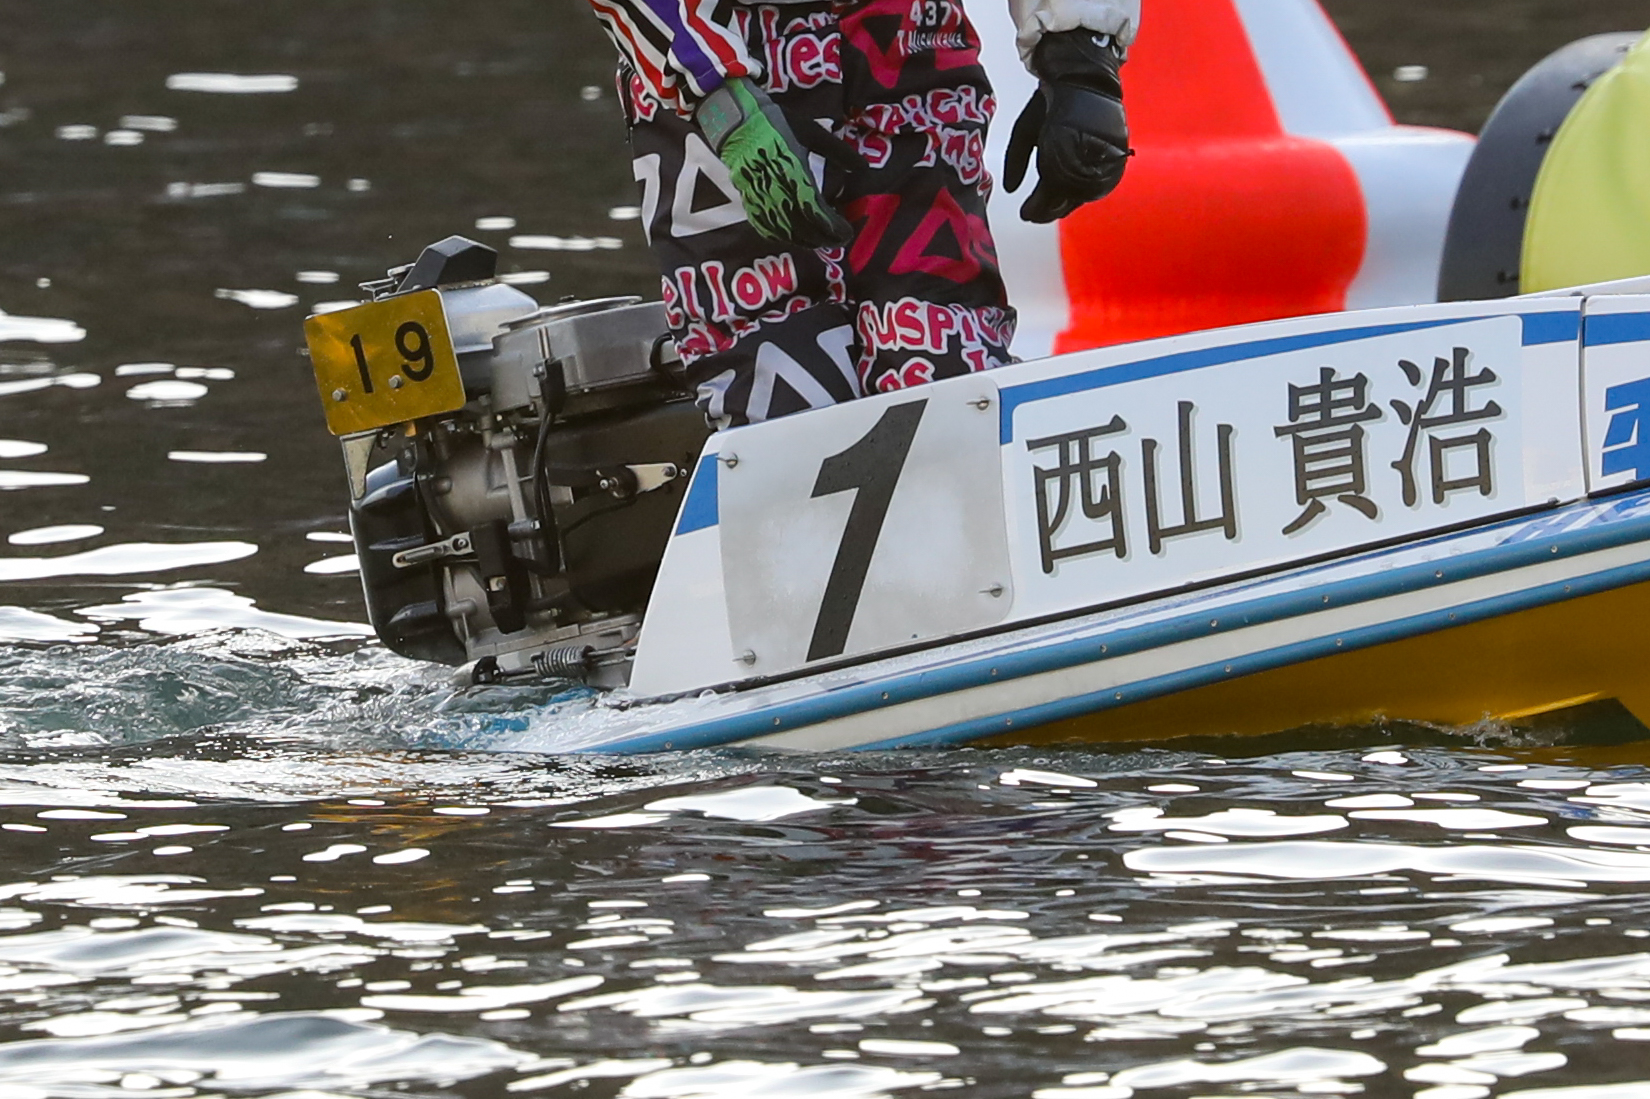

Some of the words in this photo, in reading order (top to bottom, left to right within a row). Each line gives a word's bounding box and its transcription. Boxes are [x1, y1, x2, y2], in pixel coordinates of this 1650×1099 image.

[806, 398, 930, 663] 1
[1026, 401, 1235, 574] 西山
[1273, 347, 1502, 535] 貴浩
